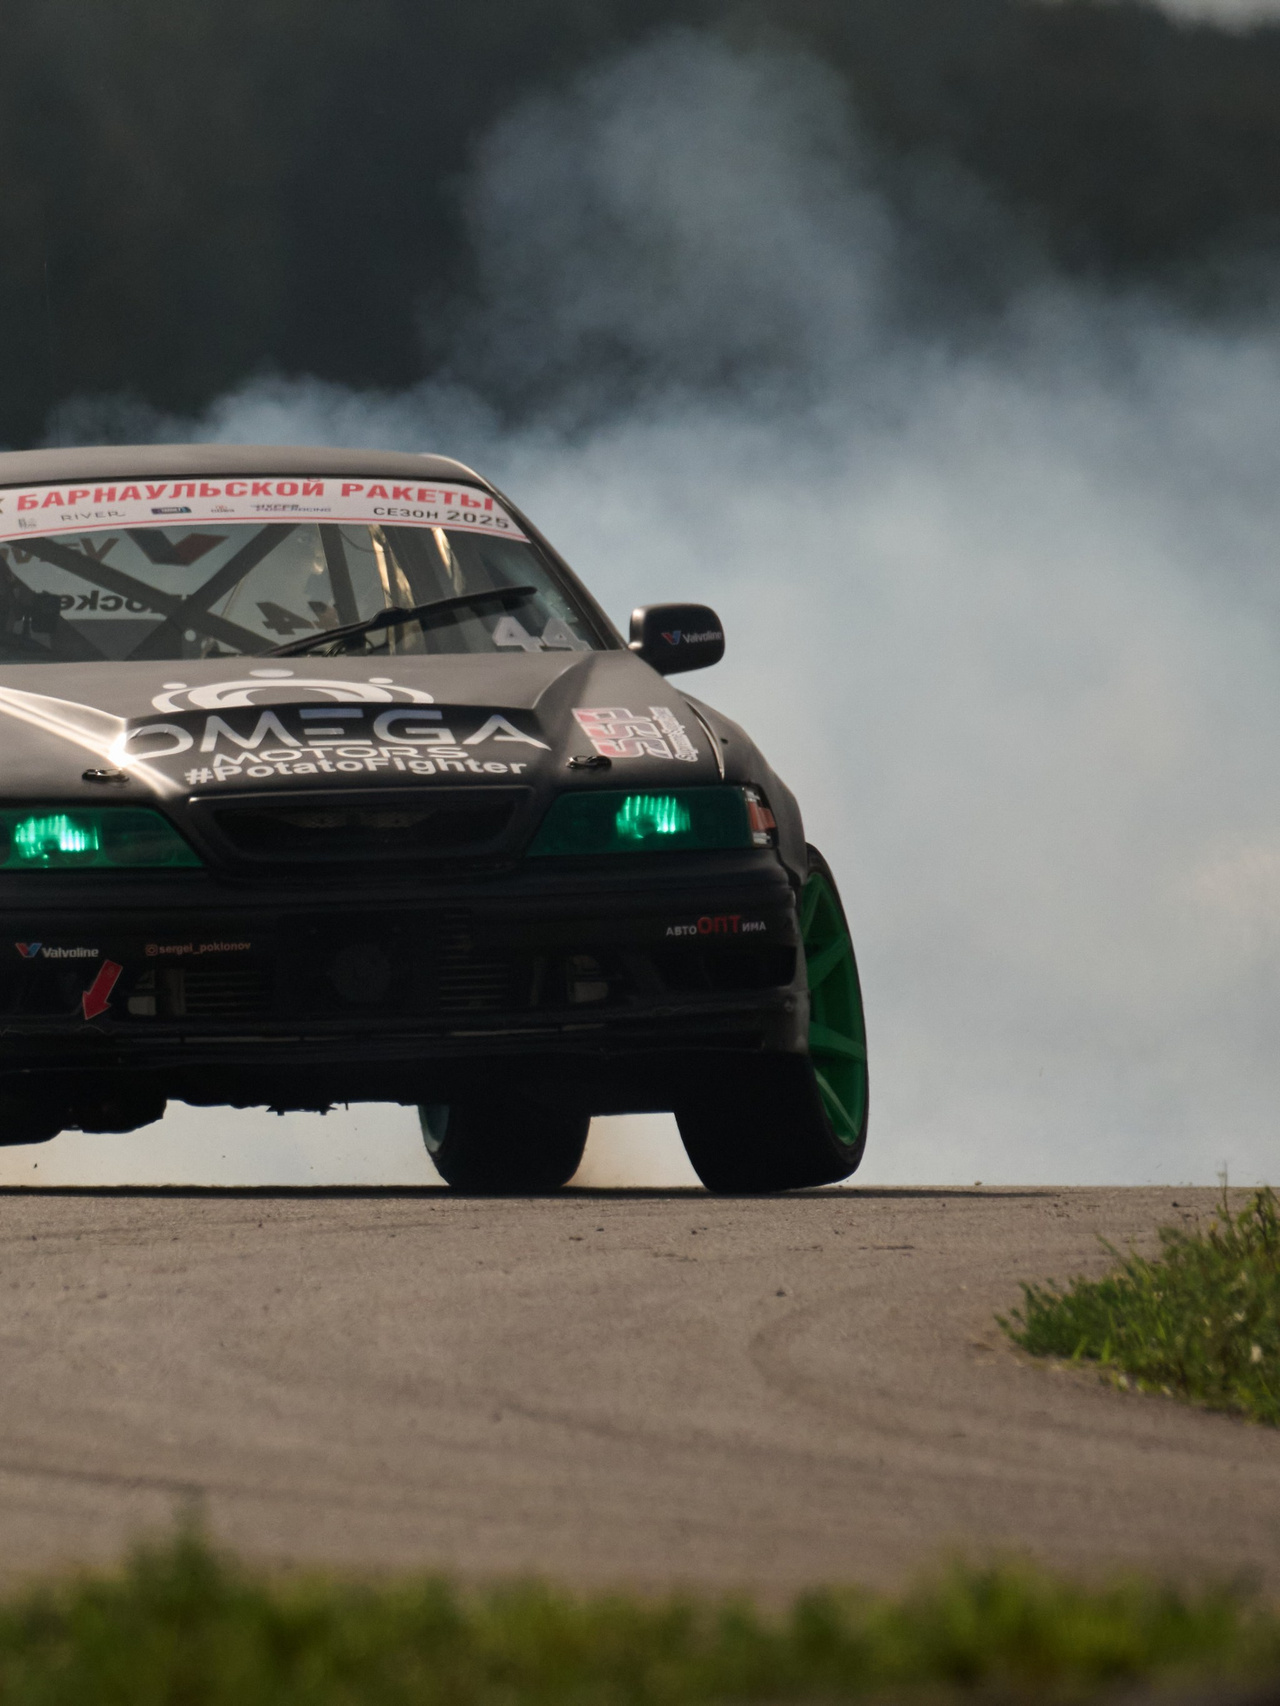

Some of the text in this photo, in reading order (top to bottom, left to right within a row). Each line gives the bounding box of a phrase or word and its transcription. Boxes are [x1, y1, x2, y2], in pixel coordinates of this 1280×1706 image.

[16, 477, 324, 512] БАРНАУЛЬСКОЙ
[340, 482, 494, 512] РАКЕТЫ
[372, 506, 510, 530] СЕЗОН 2025
[682, 630, 722, 644] Valvoline
[118, 707, 552, 761] OMEGA
[213, 746, 470, 767] MOTORS
[184, 757, 527, 786] #PotatoFighter
[41, 946, 100, 959] Valvoline
